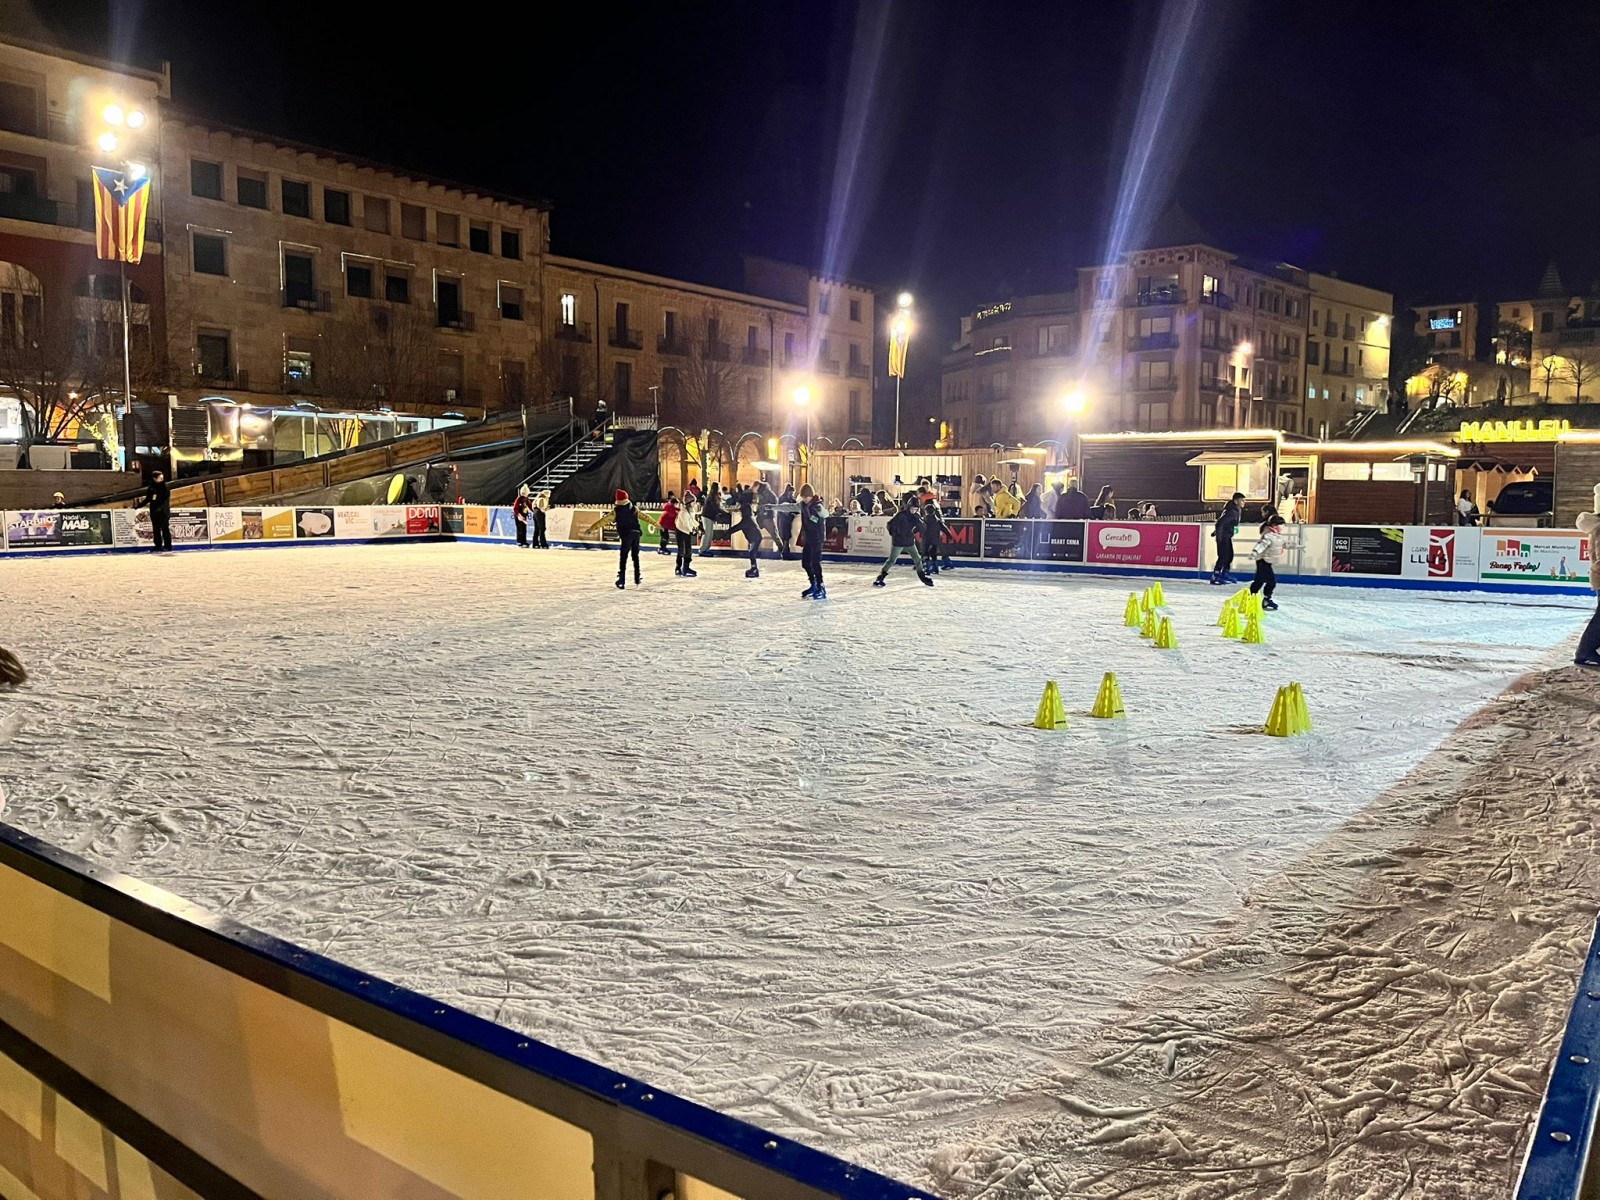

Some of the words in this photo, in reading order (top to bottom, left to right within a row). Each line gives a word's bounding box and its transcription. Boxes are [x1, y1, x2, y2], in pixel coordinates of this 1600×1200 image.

[1461, 419, 1569, 441] MANLLEU
[61, 519, 90, 530] MAB
[1165, 531, 1180, 545] 10
[1164, 544, 1178, 553] anys
